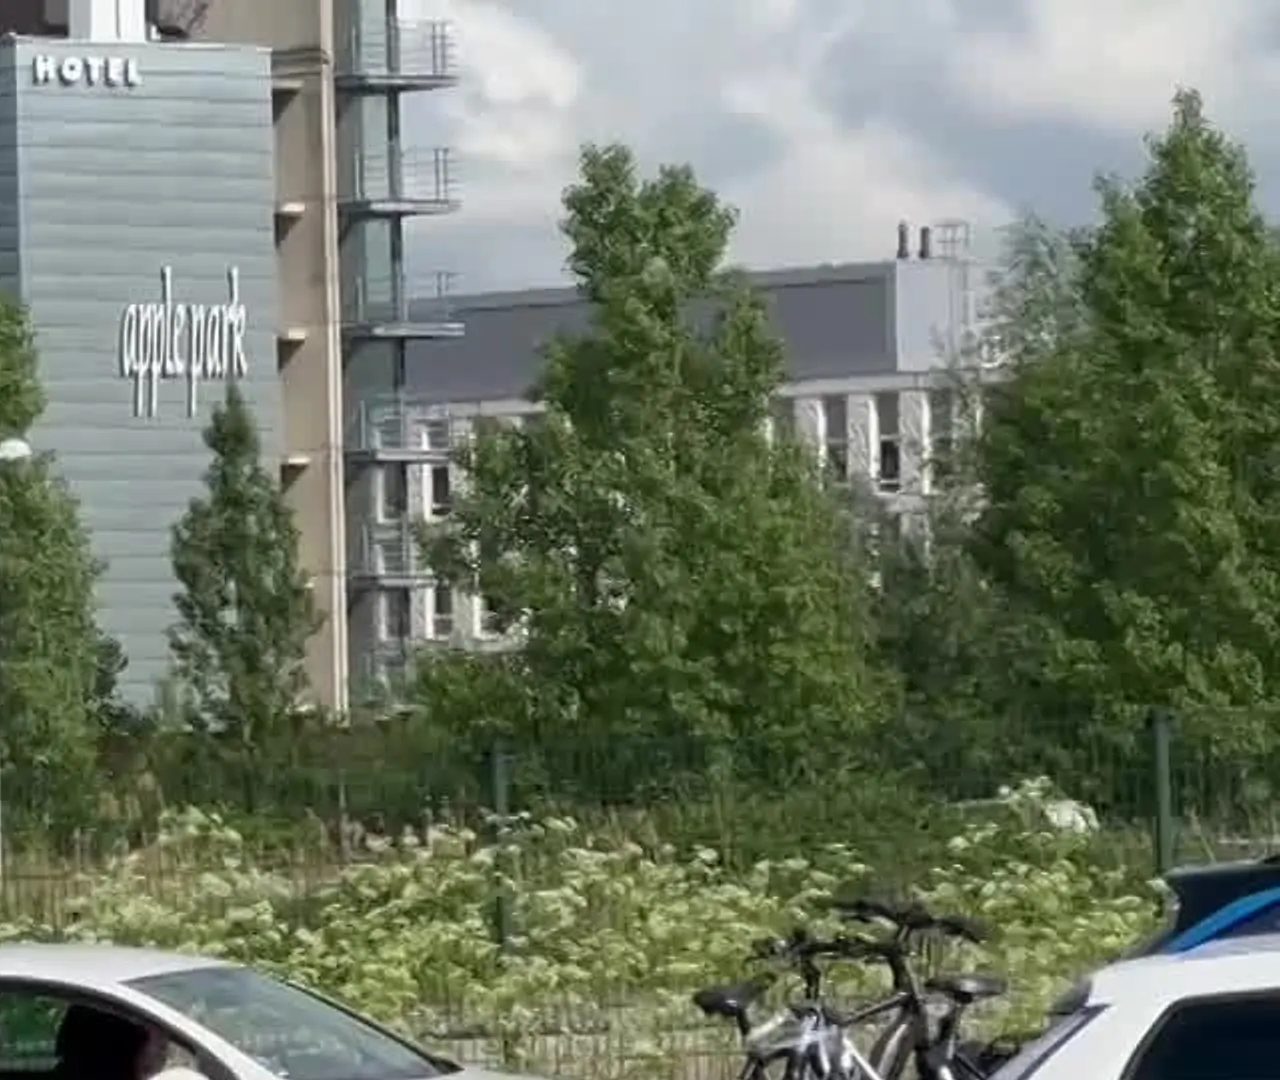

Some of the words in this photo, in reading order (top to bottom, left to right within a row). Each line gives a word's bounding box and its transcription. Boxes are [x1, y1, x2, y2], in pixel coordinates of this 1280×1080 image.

[34, 55, 140, 85] HOTEL
[123, 266, 185, 416] apple
[188, 266, 248, 416] park
